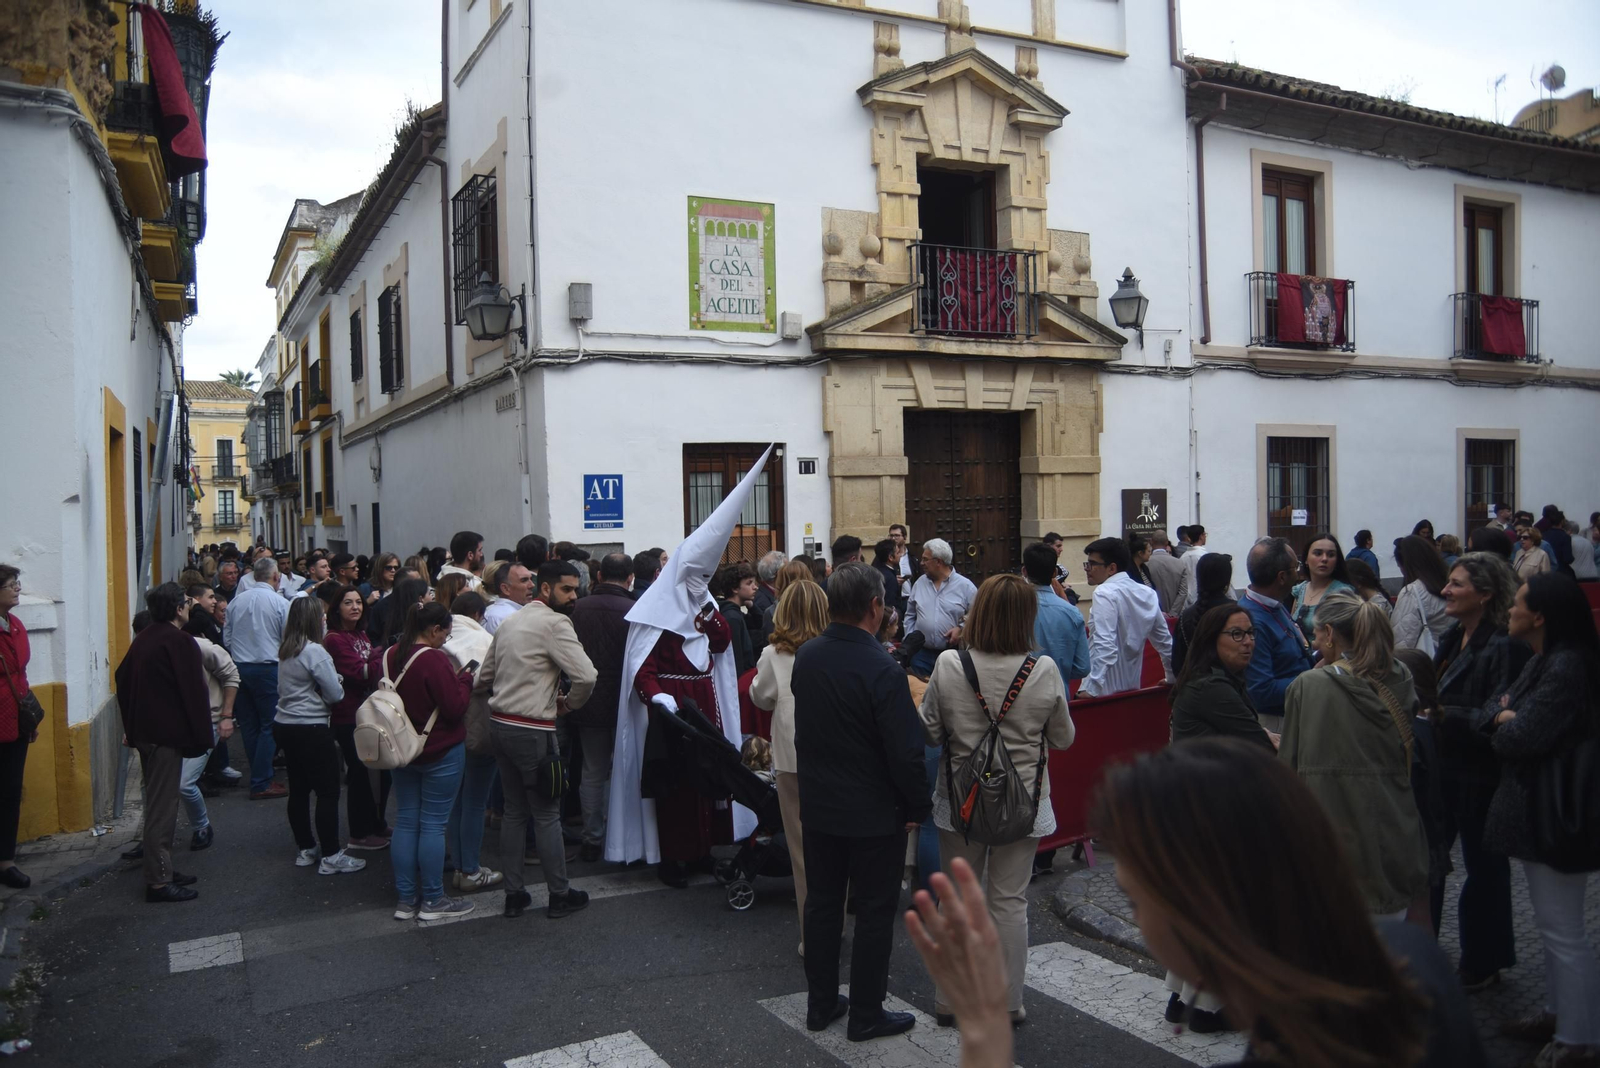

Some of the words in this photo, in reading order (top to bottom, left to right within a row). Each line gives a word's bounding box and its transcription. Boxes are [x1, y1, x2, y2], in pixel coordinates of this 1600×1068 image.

[725, 244, 741, 257] LA
[709, 259, 753, 277] CASA
[720, 278, 743, 291] DEL
[705, 297, 760, 315] ACEITE
[801, 462, 813, 473] 11
[587, 478, 619, 500] AT
